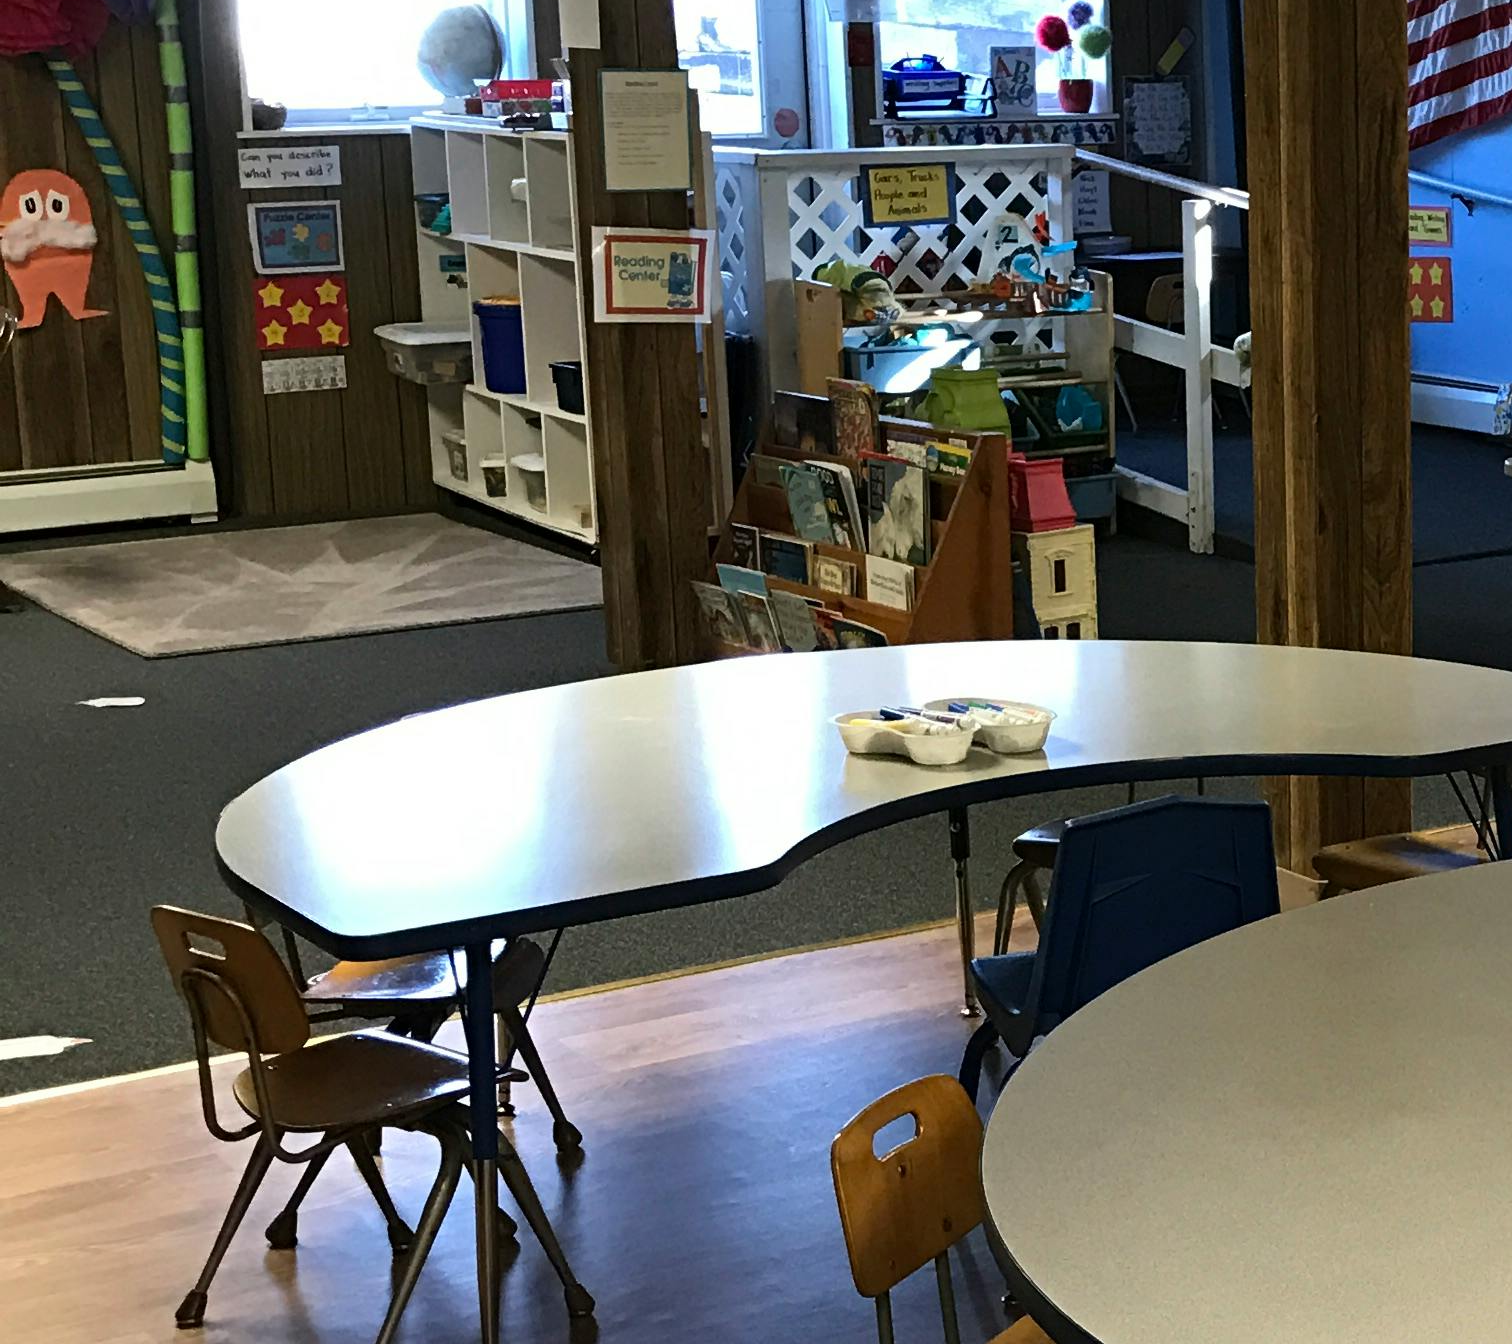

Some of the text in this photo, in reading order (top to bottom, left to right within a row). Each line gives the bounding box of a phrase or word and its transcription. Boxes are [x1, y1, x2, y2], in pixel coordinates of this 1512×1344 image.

[240, 149, 331, 163] Can you describe
[243, 168, 271, 179] what
[281, 170, 299, 180] you
[906, 170, 940, 182] Trucks
[908, 187, 927, 198] and
[888, 203, 928, 216] Animals
[614, 255, 664, 271] Reading
[619, 270, 661, 282] Center
